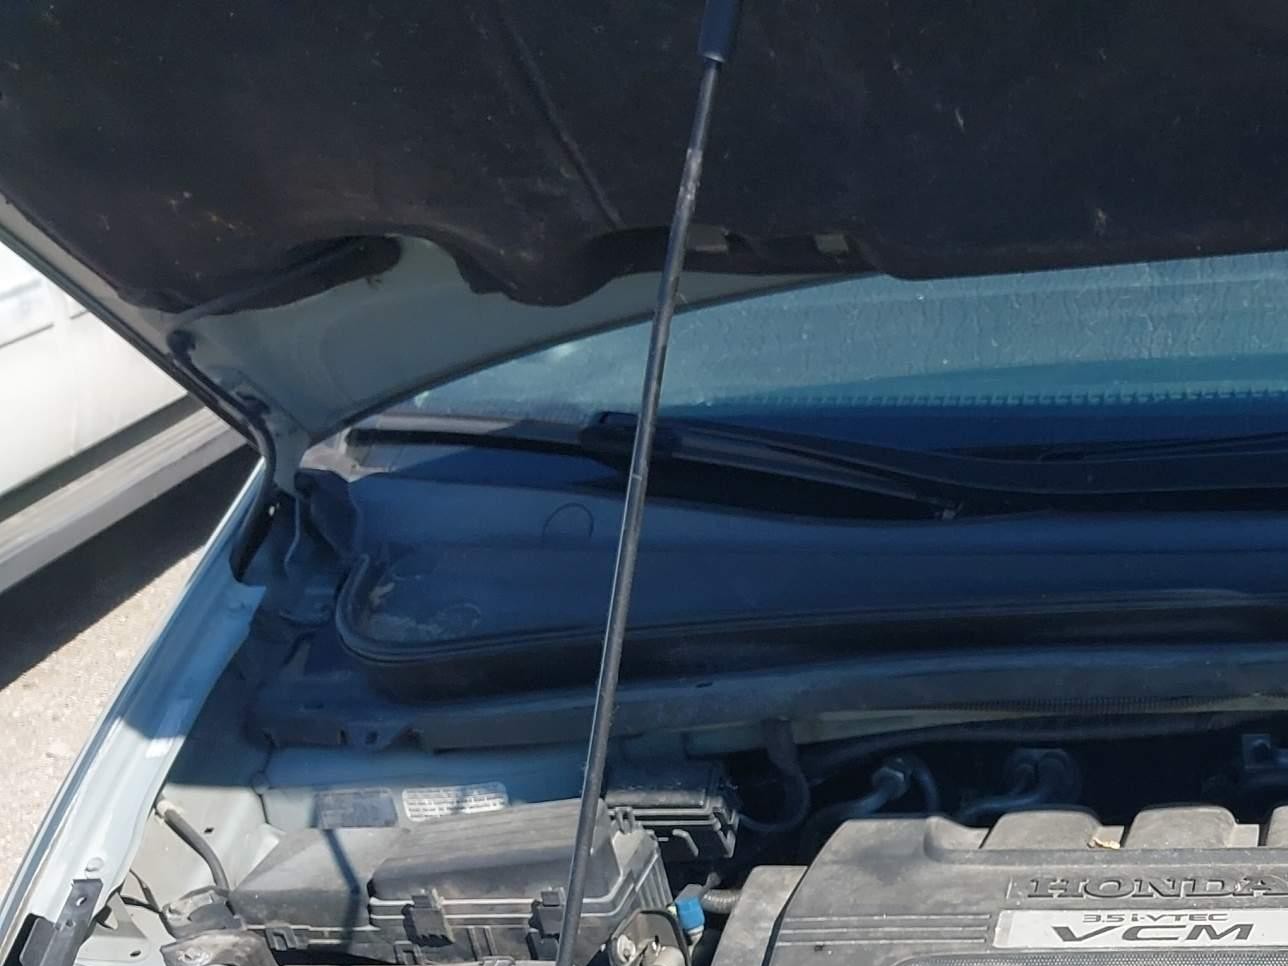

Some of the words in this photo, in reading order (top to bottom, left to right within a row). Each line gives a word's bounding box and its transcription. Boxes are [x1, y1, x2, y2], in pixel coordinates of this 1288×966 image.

[1083, 913, 1125, 923] 3.5
[1130, 912, 1229, 922] i-VTEC
[1051, 923, 1255, 942] VCM
